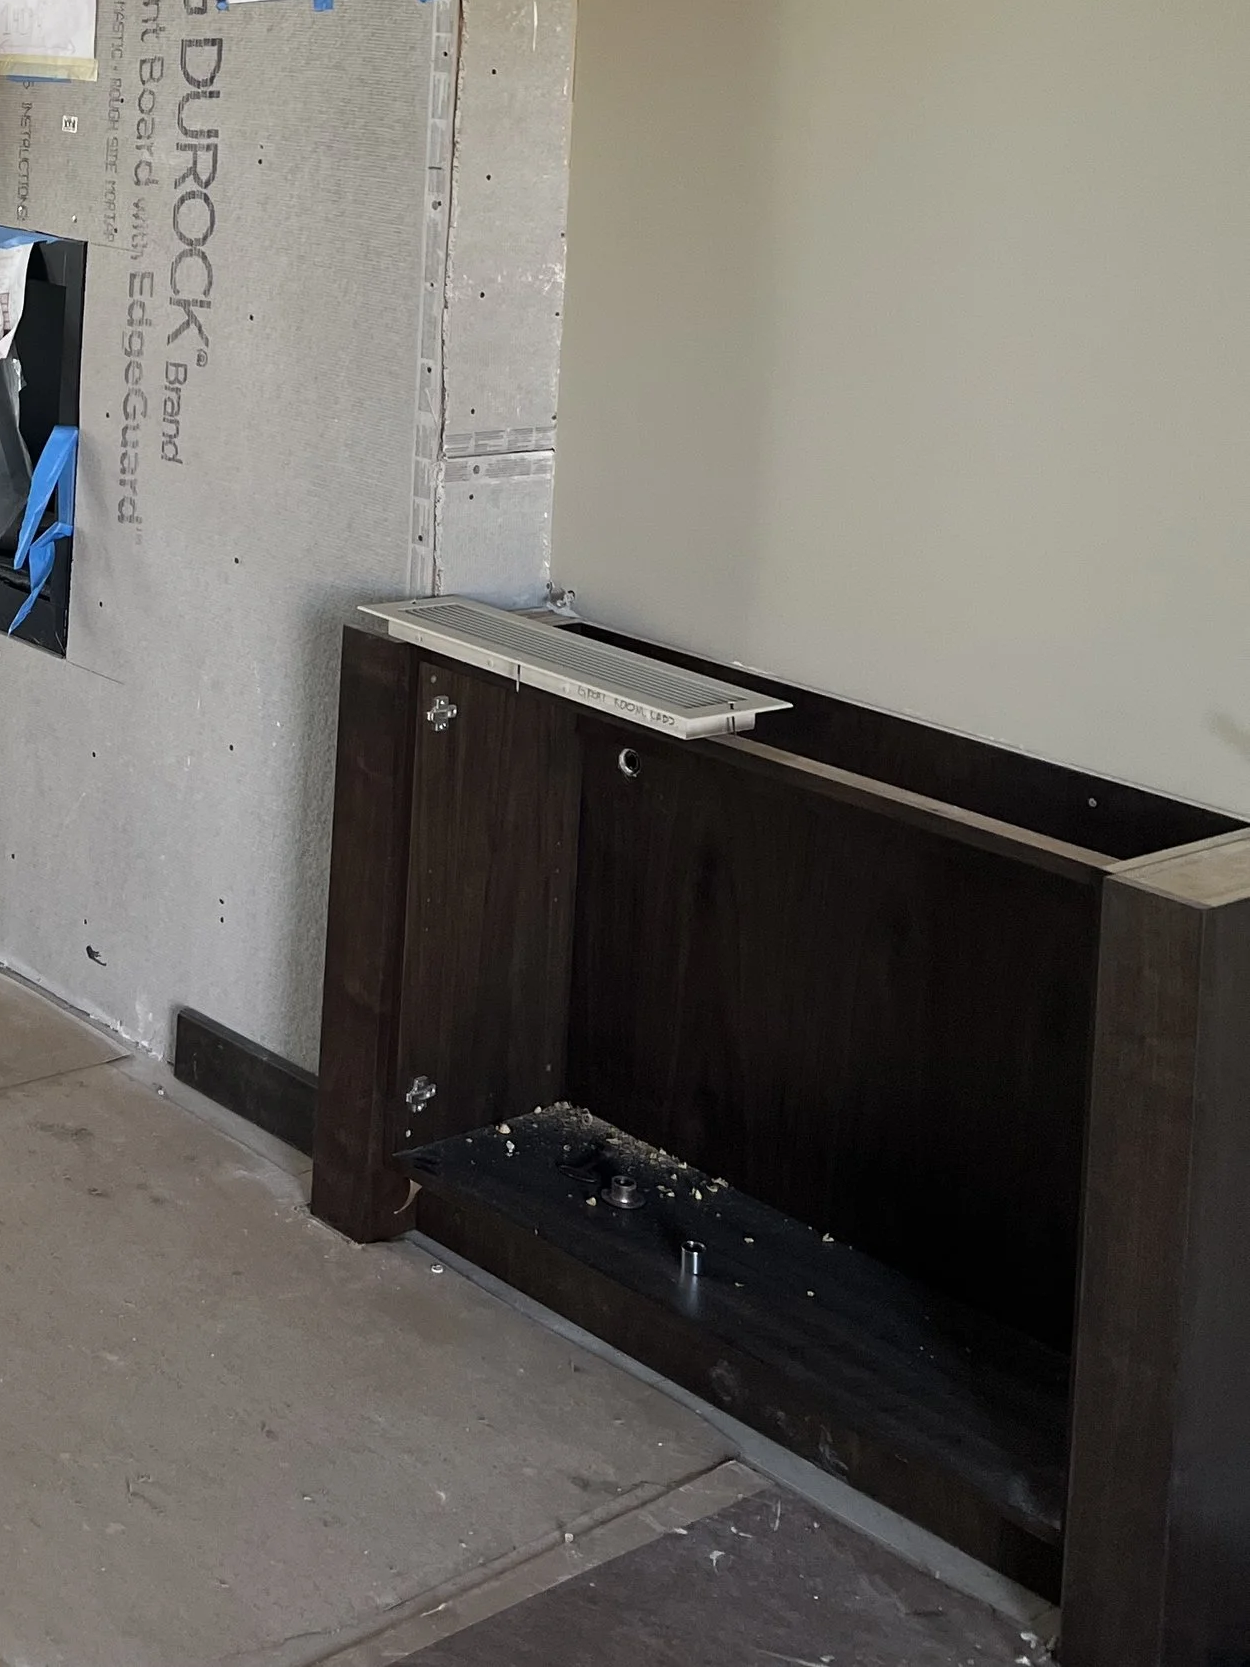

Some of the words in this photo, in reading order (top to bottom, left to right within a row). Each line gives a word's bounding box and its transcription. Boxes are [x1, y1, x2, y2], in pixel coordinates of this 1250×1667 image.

[111, 0, 126, 61] MASTIC
[107, 78, 123, 130] ROUGH
[133, 57, 164, 188] Board
[105, 136, 119, 174] SIDE
[132, 197, 150, 260] with
[161, 360, 188, 464] Brand
